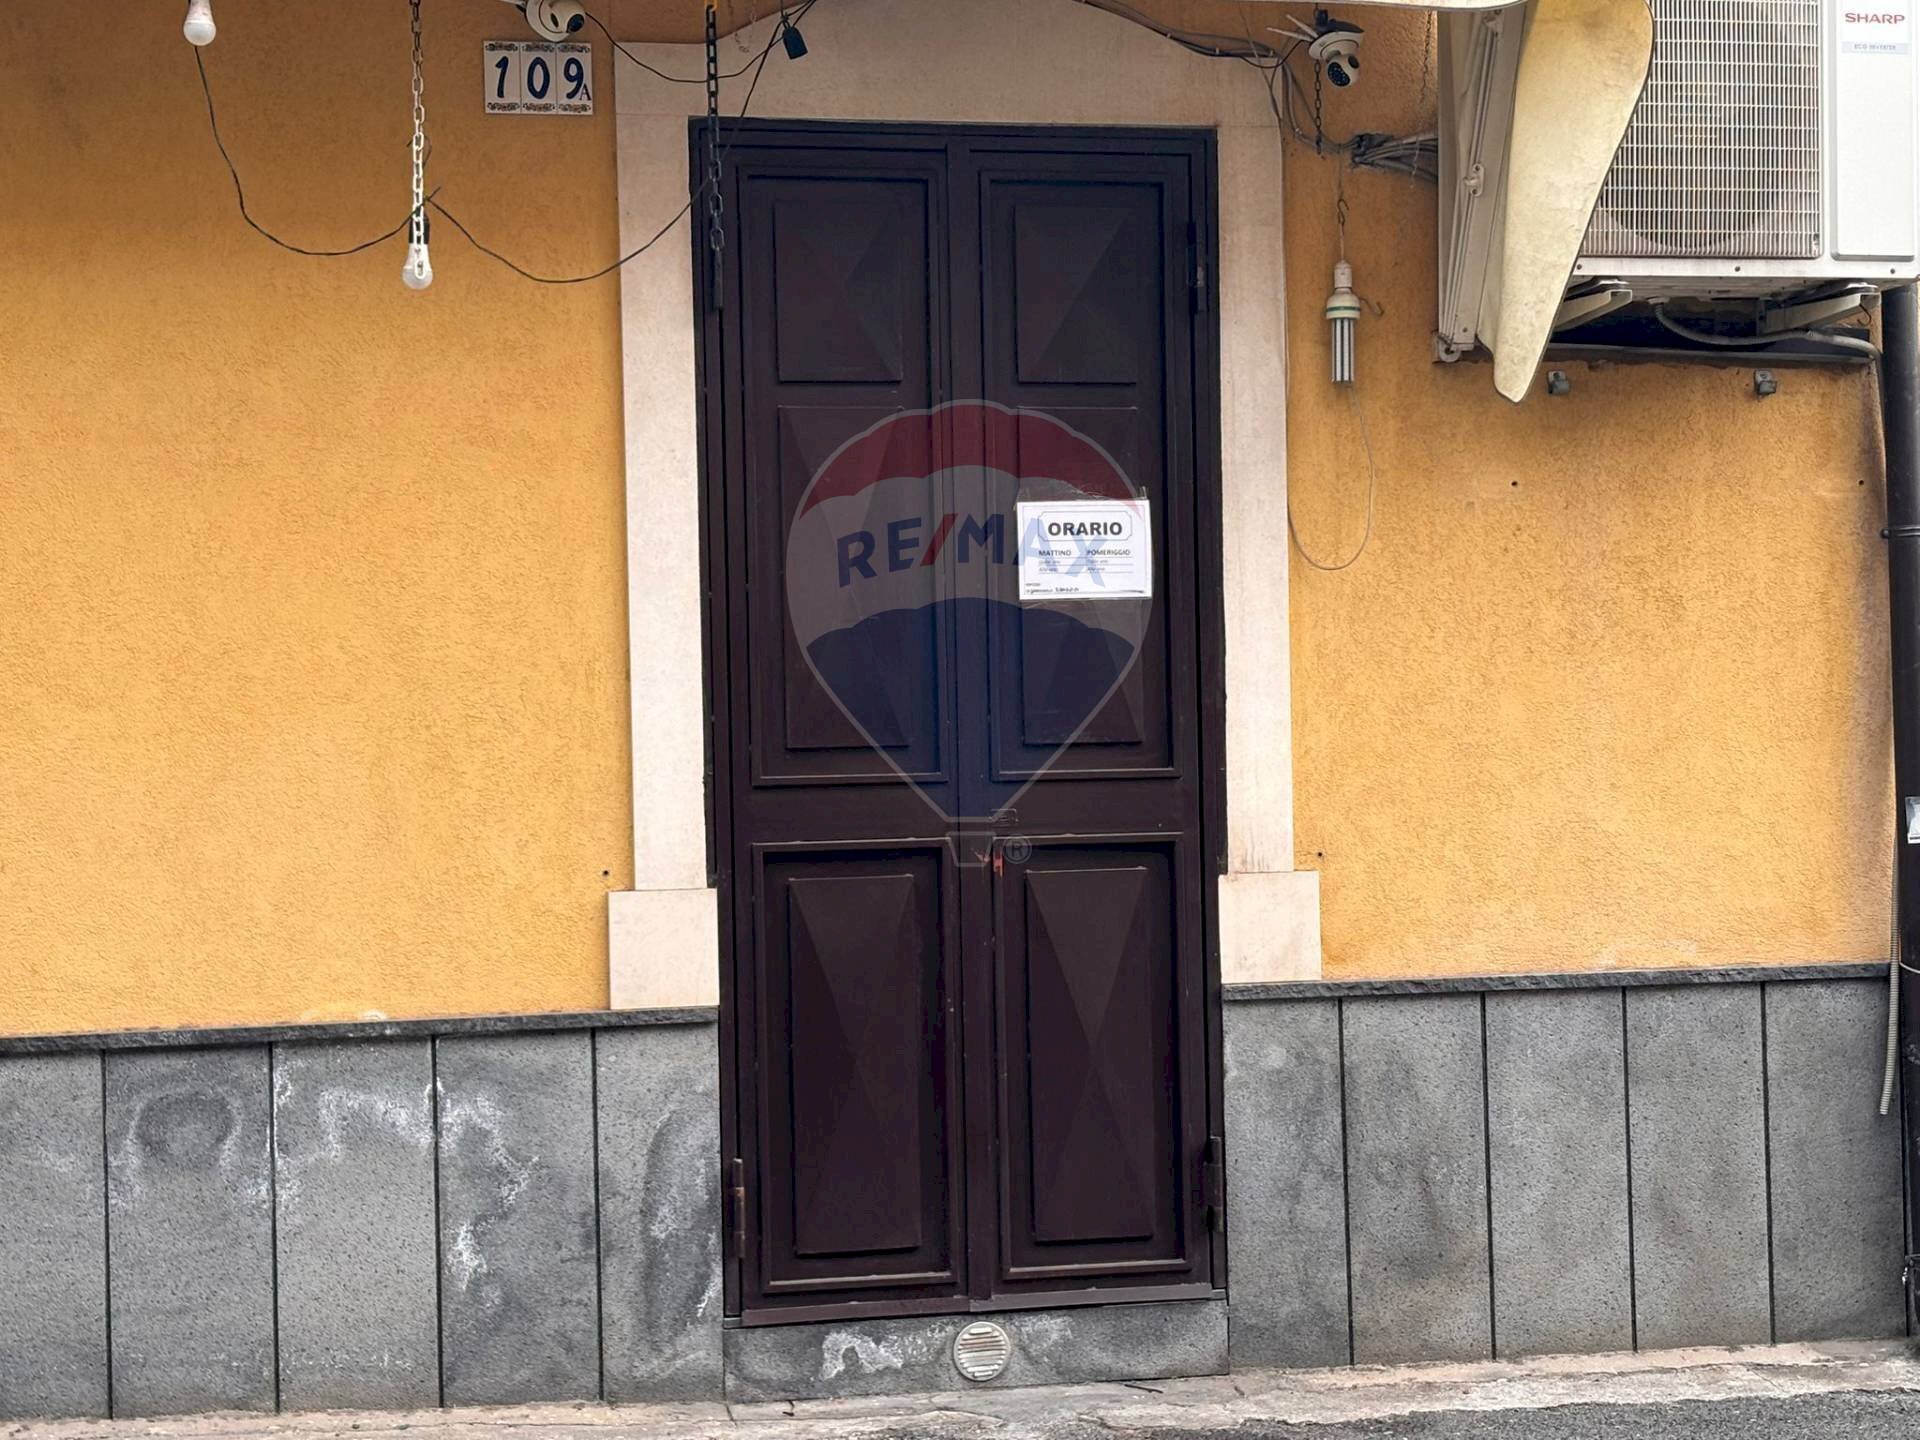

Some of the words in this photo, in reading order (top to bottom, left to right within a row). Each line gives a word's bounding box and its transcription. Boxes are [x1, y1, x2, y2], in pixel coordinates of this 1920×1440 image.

[1844, 12, 1905, 24] SHARP
[1047, 521, 1123, 536] ORARIO
[1038, 549, 1072, 557] MATTINO
